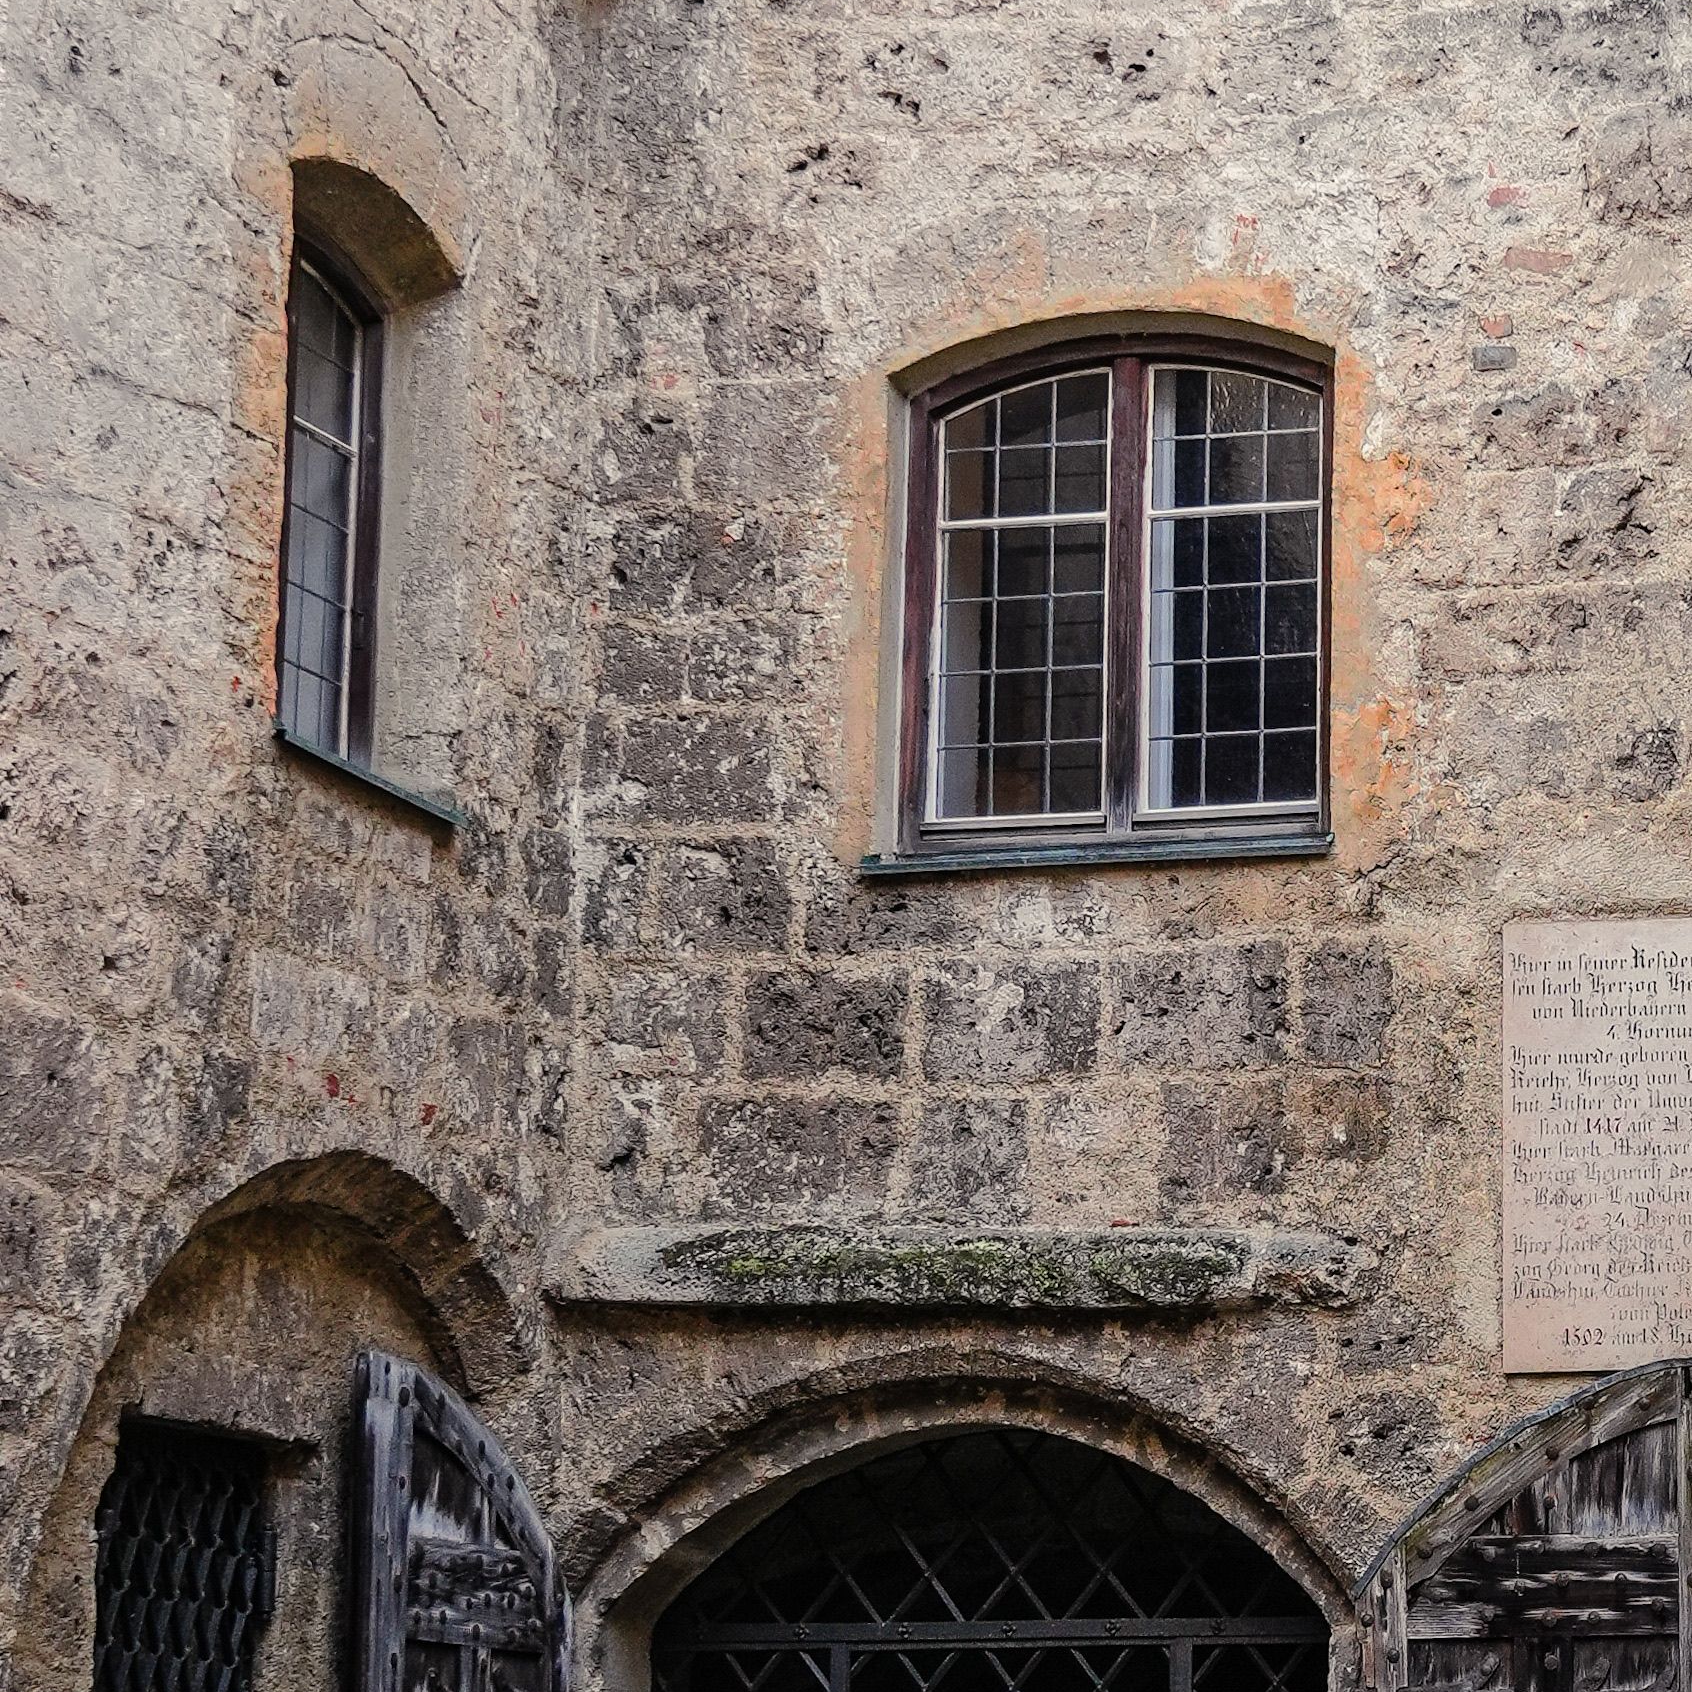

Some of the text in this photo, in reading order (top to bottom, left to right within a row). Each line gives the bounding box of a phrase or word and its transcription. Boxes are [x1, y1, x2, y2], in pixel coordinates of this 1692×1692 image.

[1508, 951, 1551, 975] Hier
[1557, 958, 1573, 971] in
[1587, 972, 1658, 1000] Herzog
[1532, 1007, 1563, 1019] von
[1509, 1045, 1551, 1069] Hier
[1557, 1047, 1613, 1064] wurde
[1619, 1042, 1688, 1068] geboren
[1576, 1067, 1640, 1092] Herzog
[1646, 1072, 1677, 1086] von
[1613, 1093, 1641, 1110] der
[1583, 1117, 1622, 1134] 1417
[1627, 1119, 1652, 1133] am
[1512, 1139, 1551, 1162] Hier
[1512, 1162, 1577, 1185] Herzog
[1511, 1233, 1551, 1258] Hier
[1563, 1327, 1604, 1347] 1502
